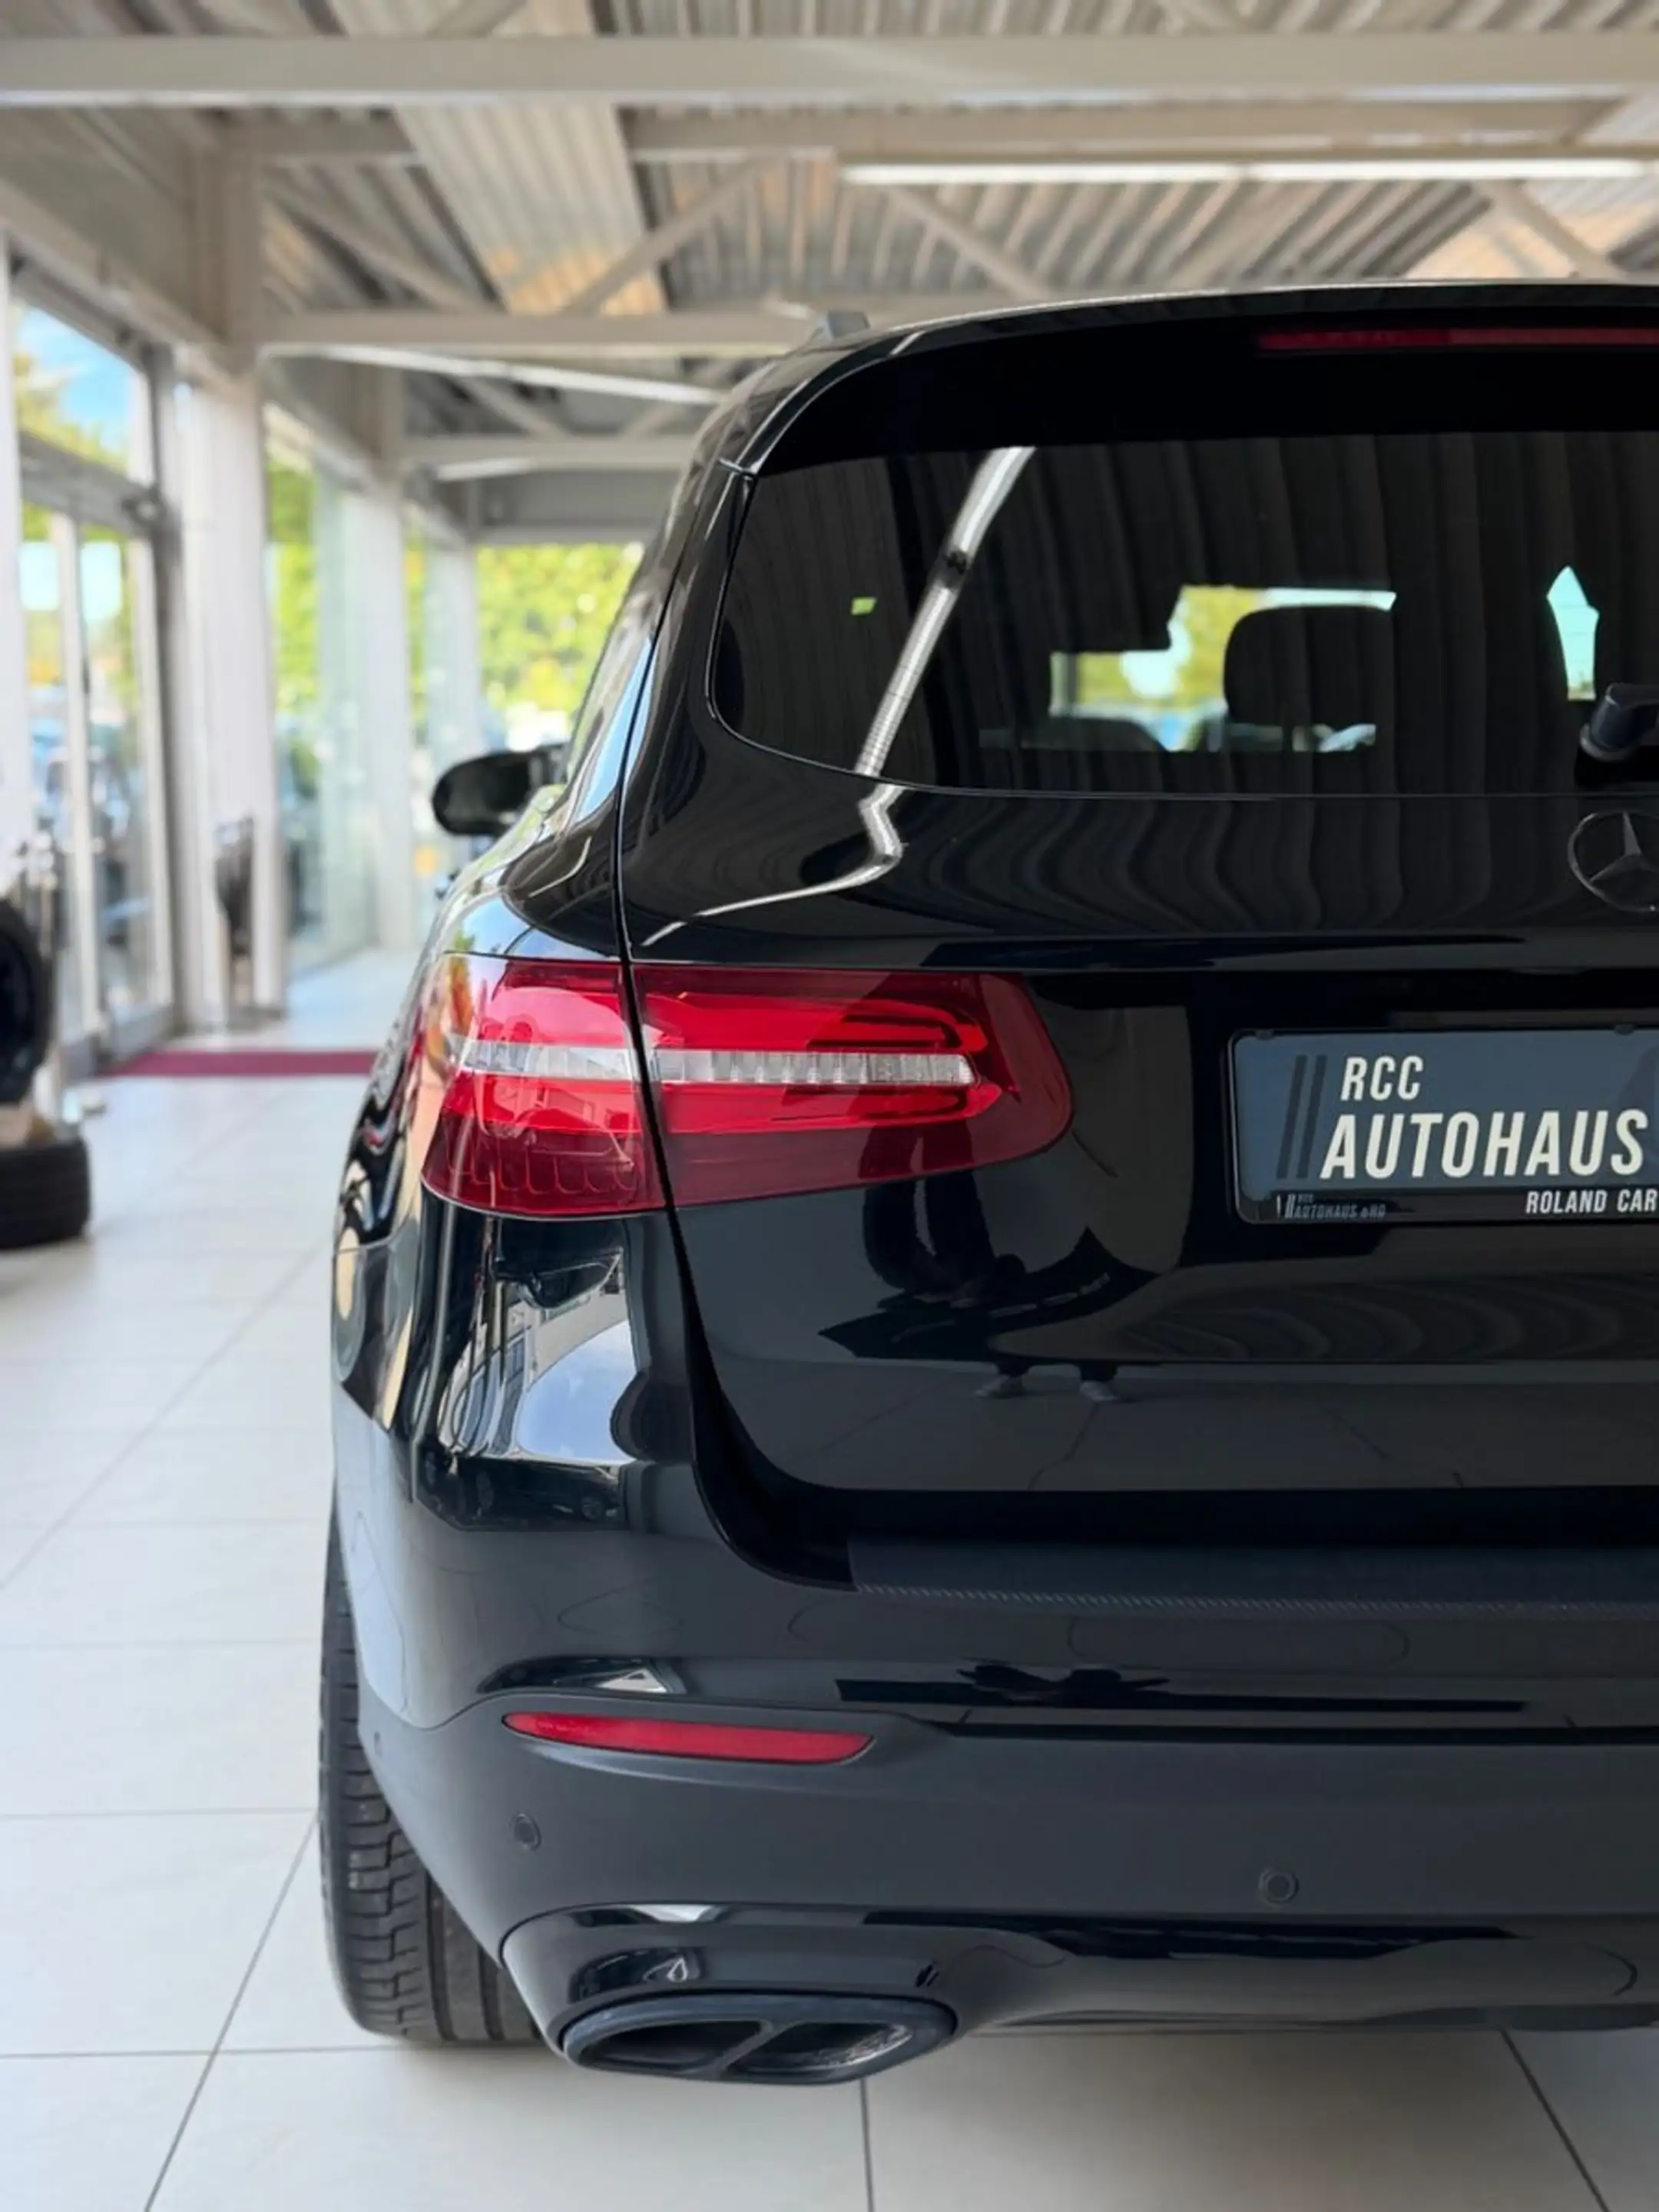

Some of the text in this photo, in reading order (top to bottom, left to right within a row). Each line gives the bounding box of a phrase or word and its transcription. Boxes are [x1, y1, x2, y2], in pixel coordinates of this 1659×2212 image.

[1340, 1055, 1423, 1101] RCC
[1320, 1108, 1649, 1179] AUTOHAUS
[1525, 1187, 1658, 1214] ROLAND CAR
